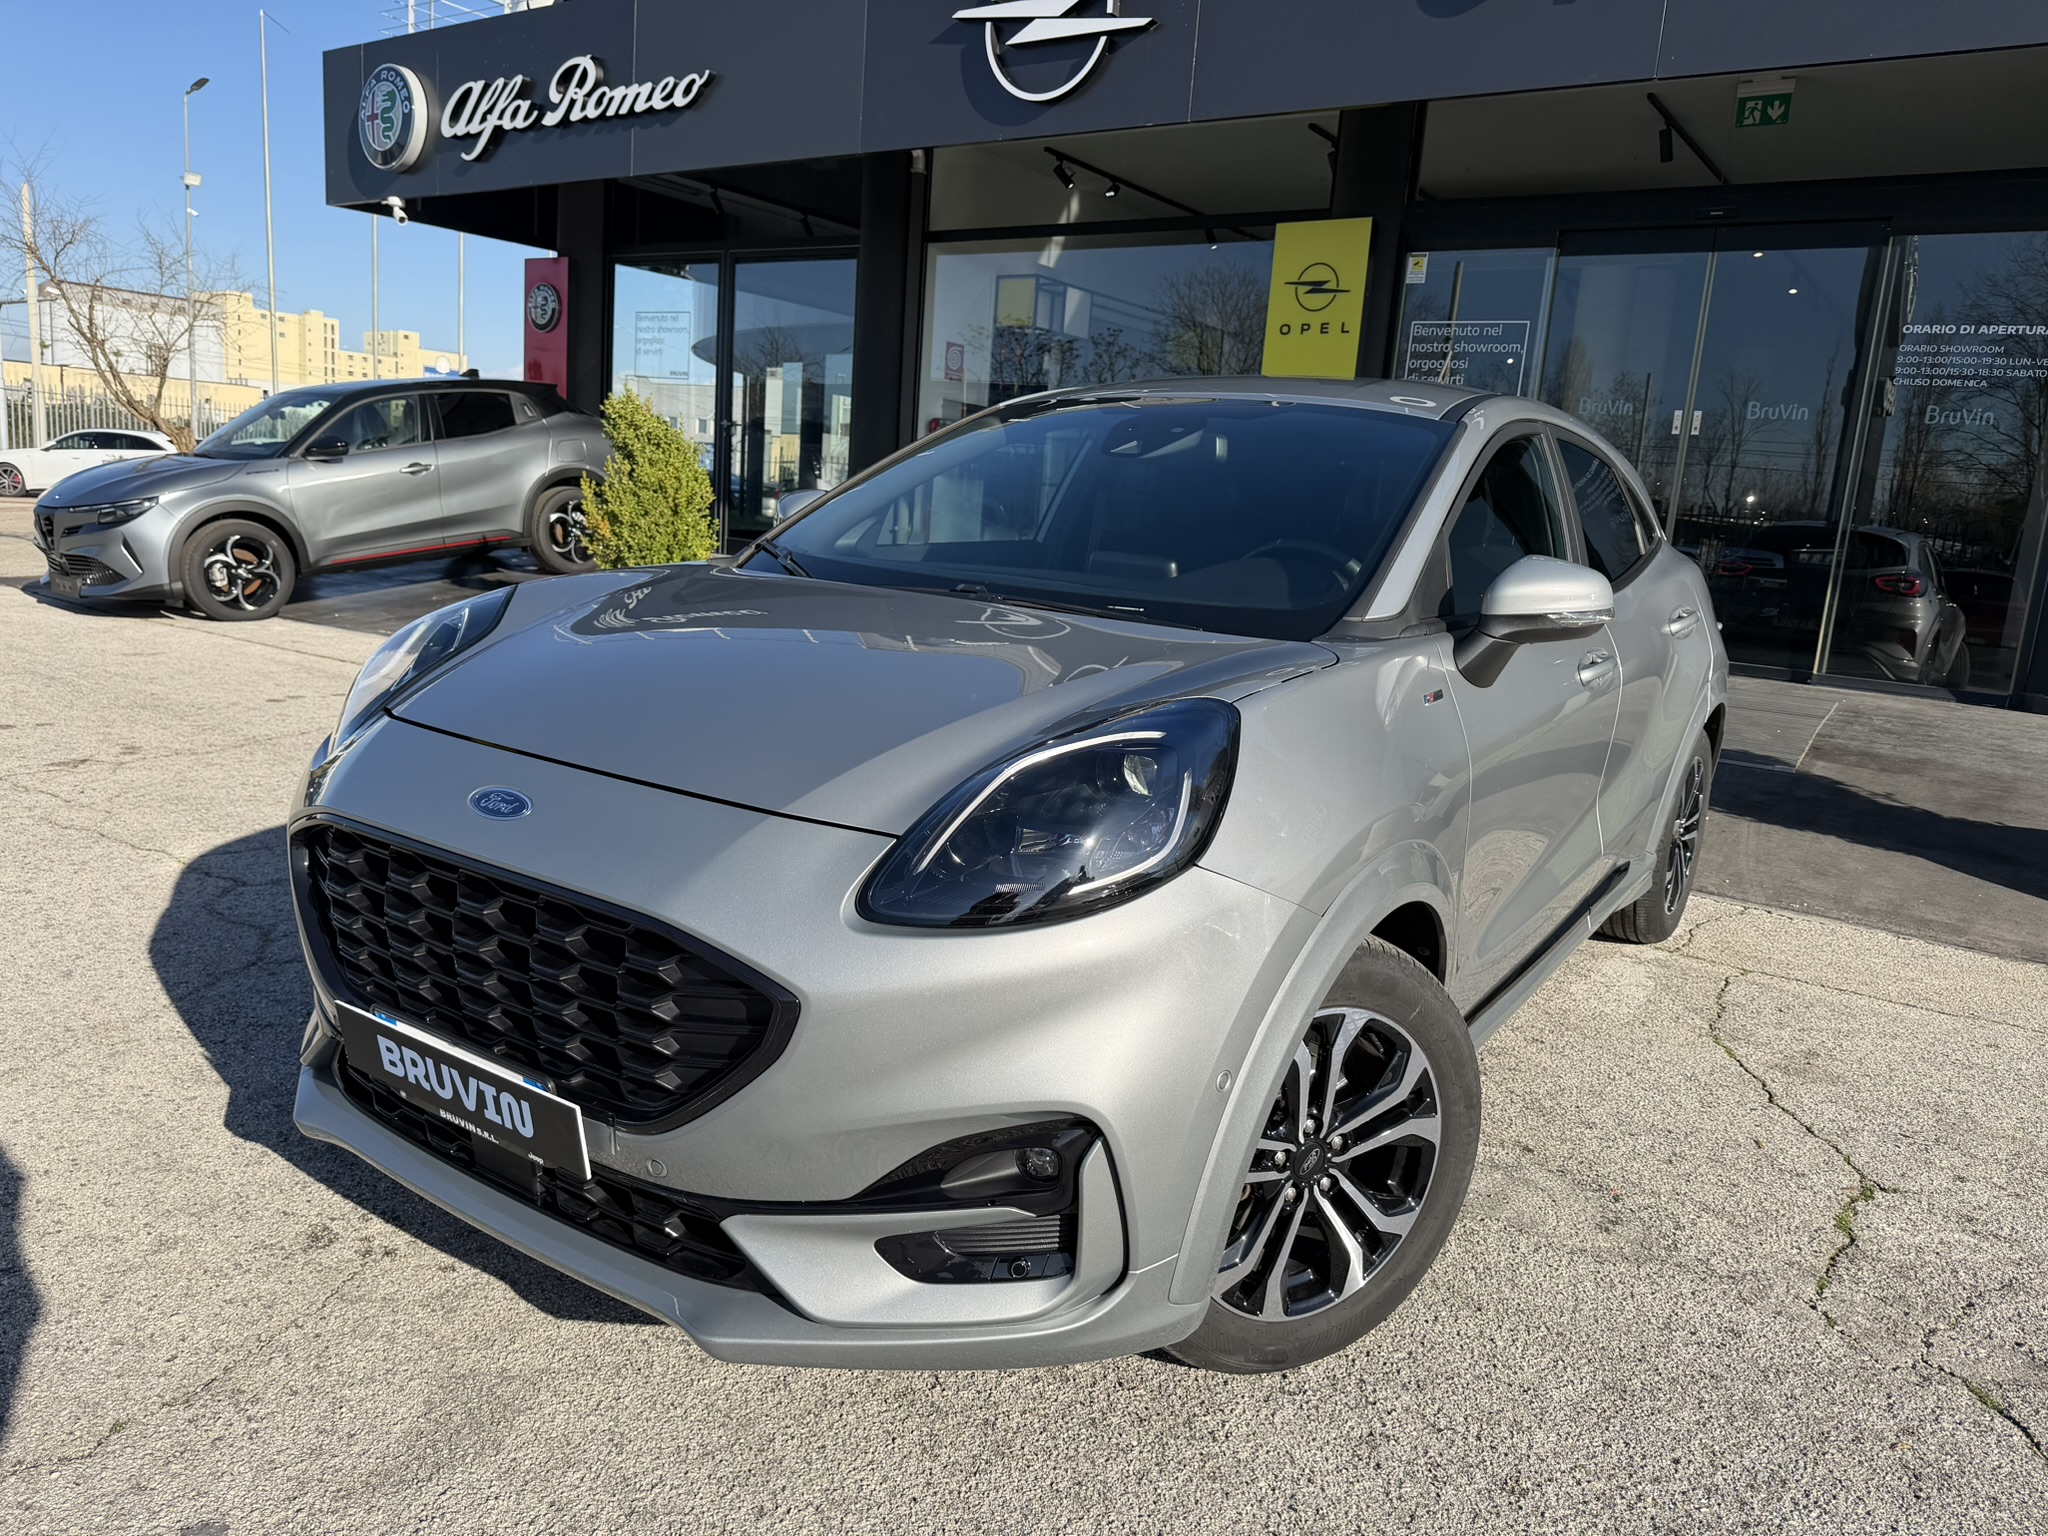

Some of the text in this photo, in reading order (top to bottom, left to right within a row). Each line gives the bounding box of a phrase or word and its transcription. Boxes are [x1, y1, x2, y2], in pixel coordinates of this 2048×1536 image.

[380, 70, 411, 114] ROMEO
[441, 54, 711, 162] Alfa Romeo
[1279, 322, 1350, 336] OPEL
[1413, 323, 1503, 336] Benvenuto nel
[1902, 324, 1957, 334] ORARIO
[1959, 324, 1975, 334] DI
[1411, 340, 1524, 355] nostro showroom,
[1899, 344, 2005, 354] ORARIO SHOWROOM
[1408, 357, 1469, 371] orgogiosi
[2006, 369, 2048, 378] SABATO
[1893, 377, 1988, 388] CHIUSO DOMENICA
[1578, 398, 1634, 416] BruVin
[1746, 400, 1809, 421] BruVin
[1924, 405, 1995, 426] BruVin
[480, 792, 520, 814] Ford
[376, 1034, 535, 1138] BRUVIN
[439, 1108, 500, 1144] BRUVIN S.R.L.
